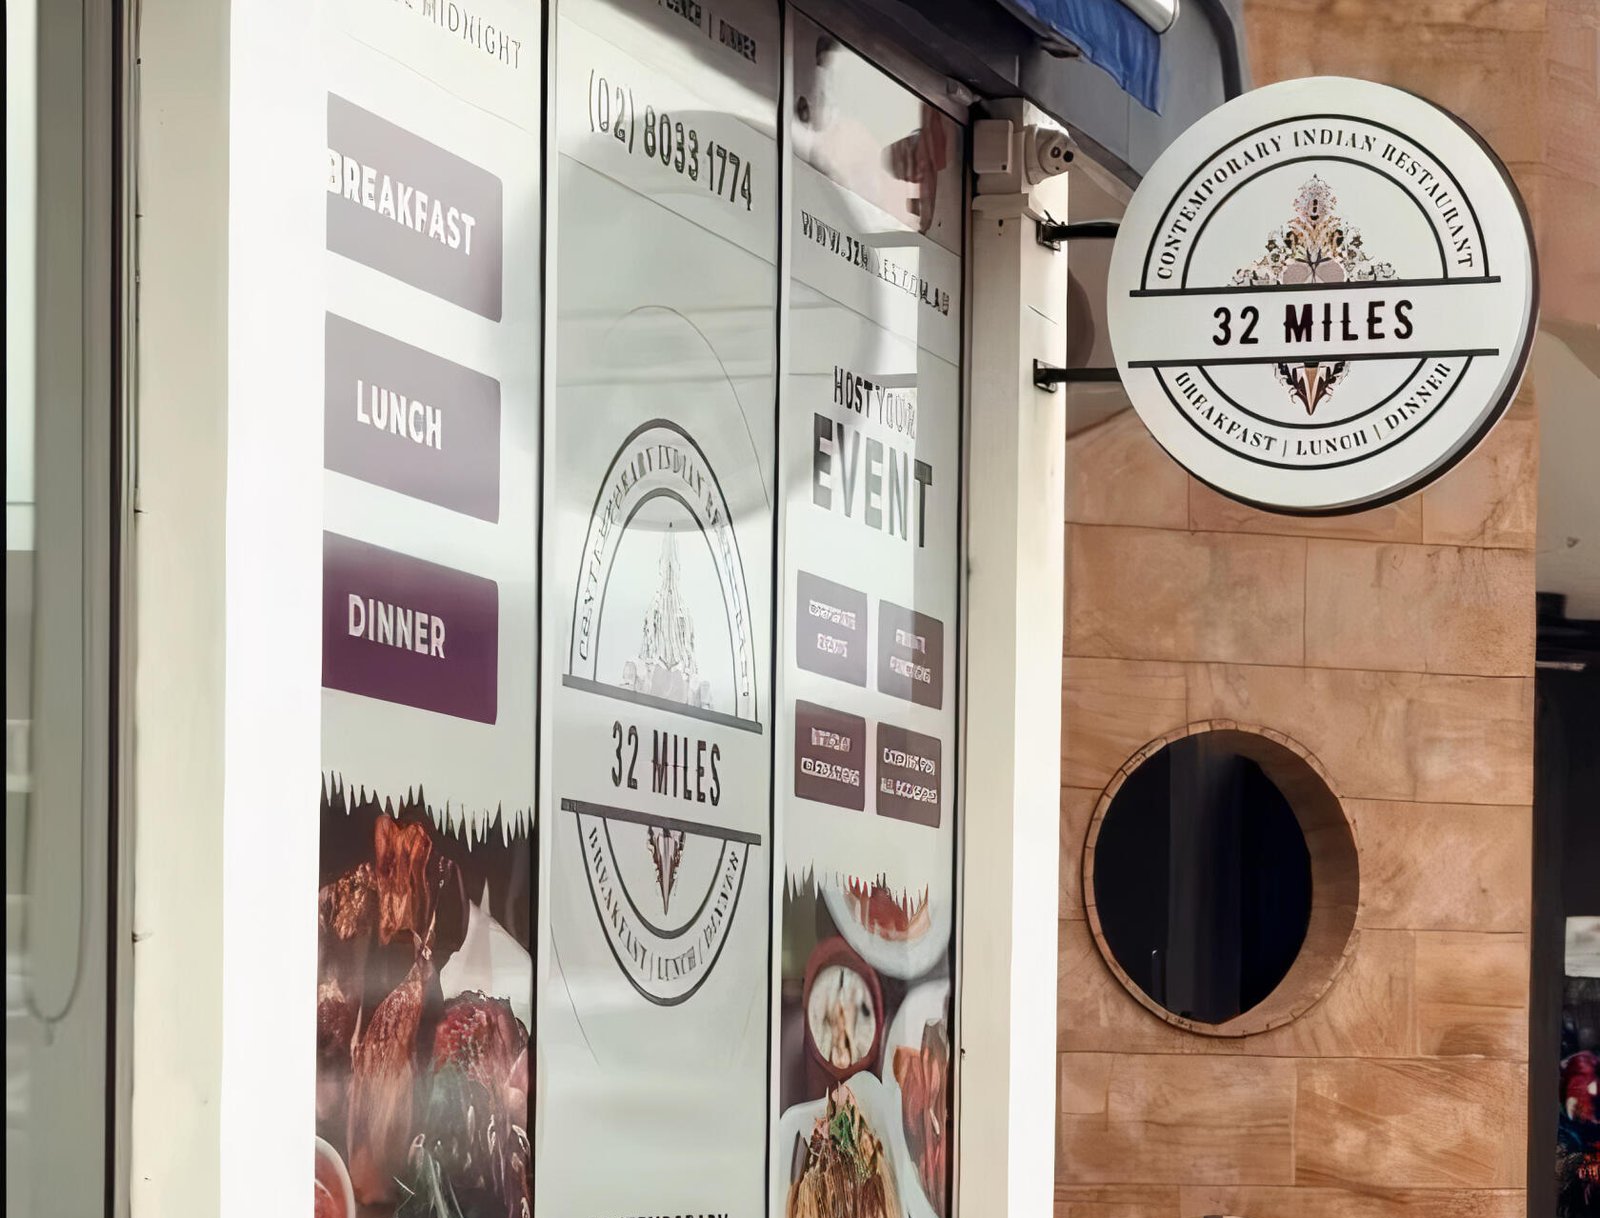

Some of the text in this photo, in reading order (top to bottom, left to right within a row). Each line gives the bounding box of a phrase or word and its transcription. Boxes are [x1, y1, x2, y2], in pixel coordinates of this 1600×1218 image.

[588, 69, 752, 211] (02) 8033 1774
[326, 148, 476, 256] BREAKFAST
[1157, 129, 1474, 280] CONTEMPORARY INDIAN RESTAURANT
[1212, 300, 1414, 347] 32 MILES
[356, 380, 443, 450] LUNCH
[834, 365, 873, 419] HOST
[1175, 362, 1451, 456] BREAKFAST LUNCH DINNER
[812, 412, 933, 548] EVENT
[348, 593, 446, 659] DINNER
[611, 720, 721, 807] 32 MILES
